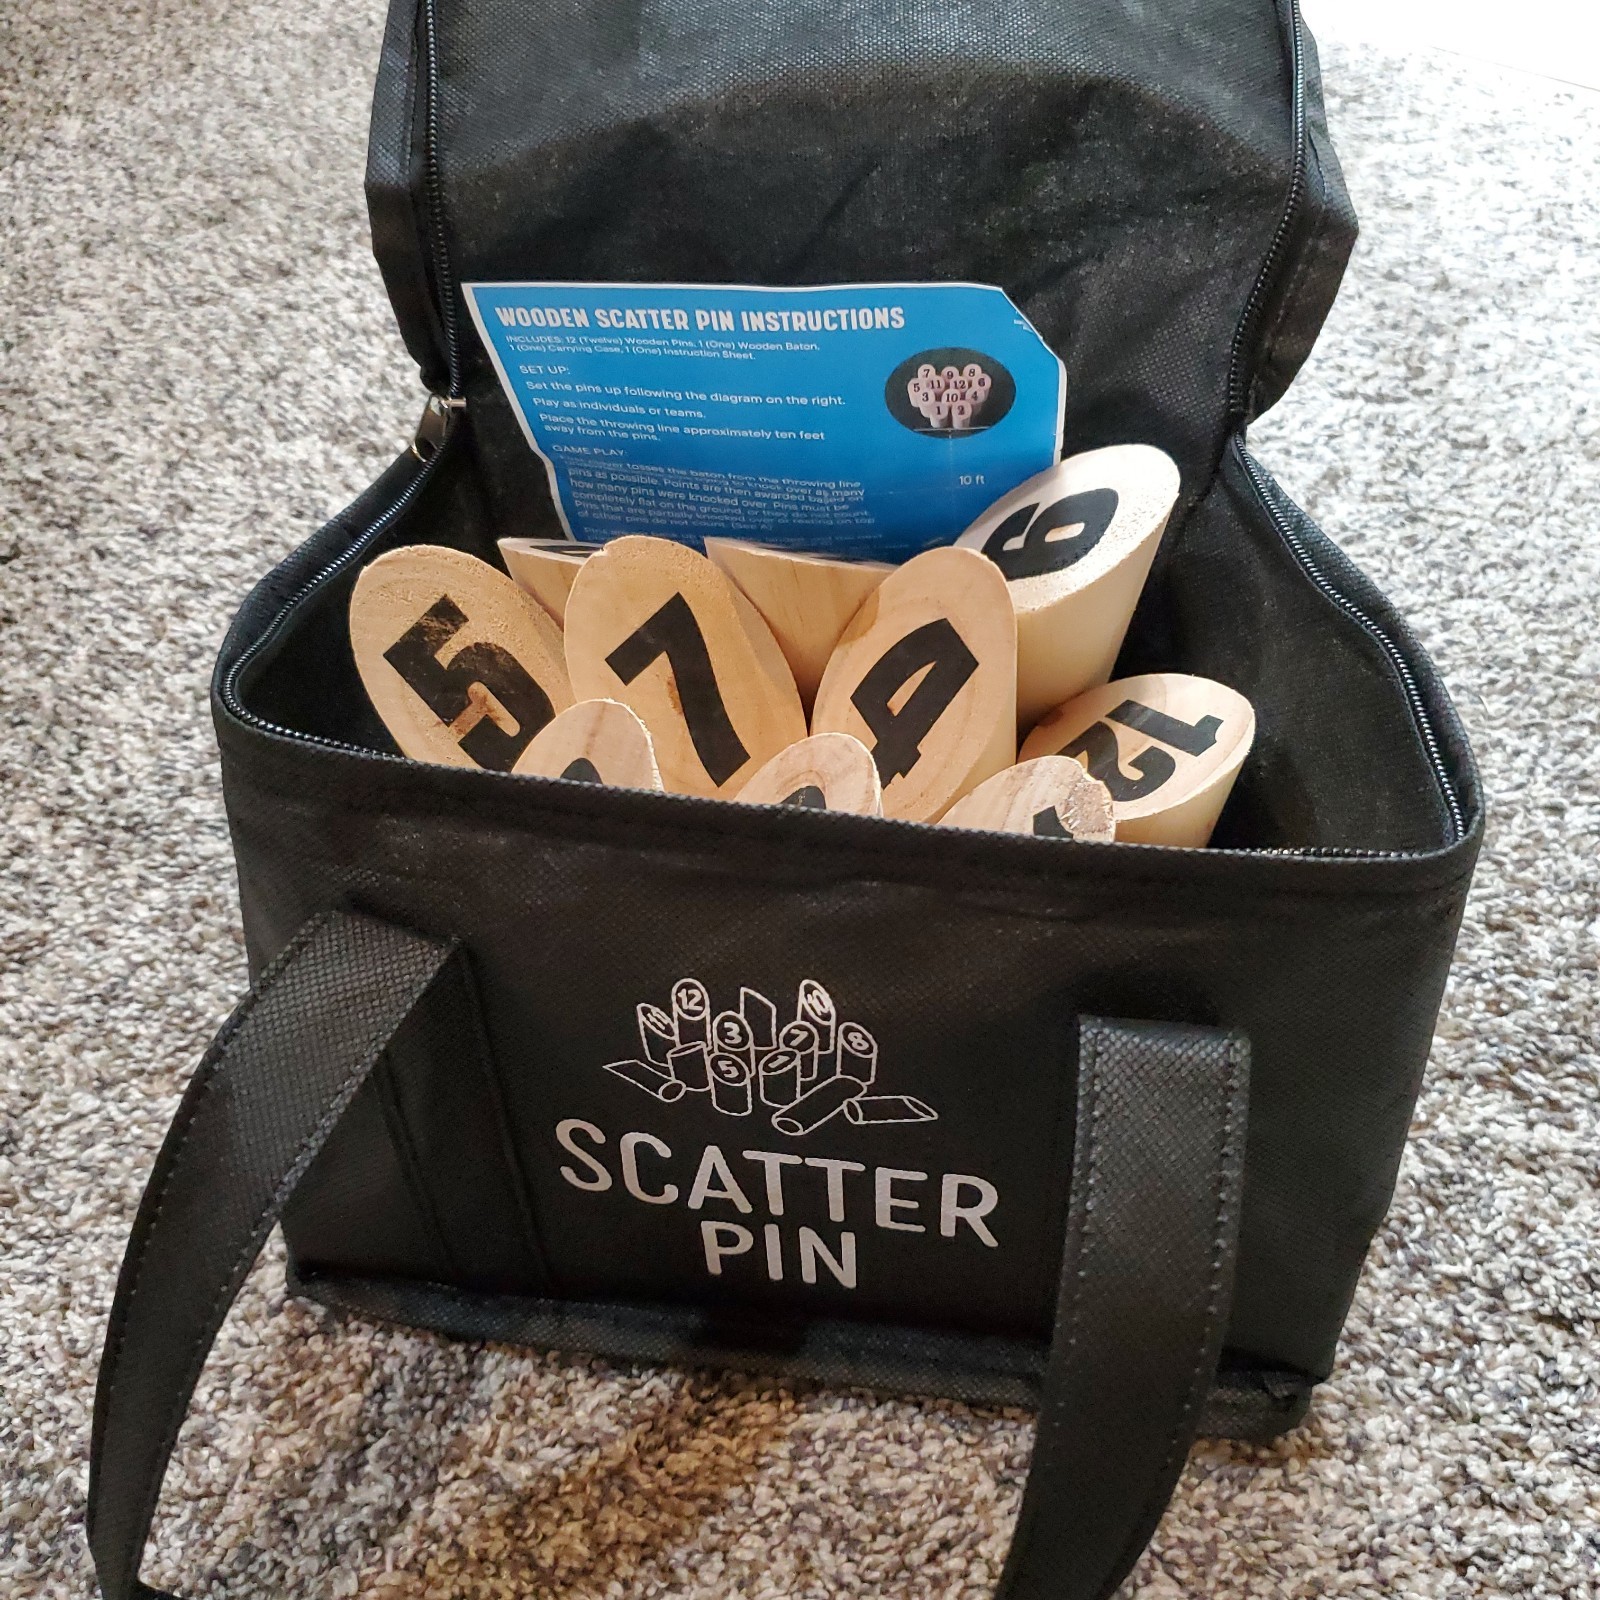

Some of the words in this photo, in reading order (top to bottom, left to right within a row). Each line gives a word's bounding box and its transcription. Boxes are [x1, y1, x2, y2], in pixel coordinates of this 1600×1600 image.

[495, 307, 590, 328] WOODEN
[594, 308, 690, 330] SCATTER
[695, 309, 735, 331] PIN
[741, 306, 905, 332] INSTRUCTIONS
[517, 344, 546, 353] (One)
[548, 345, 593, 354] Carrying
[632, 347, 662, 356] (One)
[664, 347, 720, 358] Instruction
[722, 350, 756, 360] Sheet.
[565, 336, 576, 344] 12
[579, 336, 623, 346] (Twelve)
[624, 337, 670, 347] Wooden
[705, 340, 735, 350] (One)
[738, 341, 783, 351] Wooden
[519, 365, 544, 375] SET
[548, 366, 570, 375] UP:
[923, 369, 930, 378] 7
[946, 371, 953, 379] 9
[968, 369, 975, 377] 8
[913, 383, 920, 392] 5
[931, 380, 940, 389] 11
[954, 380, 966, 389] 12
[978, 378, 985, 387] 6
[526, 381, 548, 390] Set
[550, 382, 572, 391] the
[576, 384, 601, 393] pins
[605, 387, 622, 395] up
[624, 386, 682, 400] following
[685, 391, 707, 401] the
[710, 392, 763, 404] diagram
[766, 396, 783, 404] on
[785, 396, 808, 405] the
[811, 396, 846, 407] right.
[922, 392, 929, 401] 3
[946, 393, 958, 402] 10
[971, 391, 978, 400] 4
[532, 397, 560, 408] Play
[562, 400, 577, 408] as
[579, 402, 646, 415] individuals
[648, 407, 662, 415] or
[664, 408, 706, 419] teams.
[958, 405, 965, 415] 2
[539, 413, 574, 424] Place
[576, 416, 598, 427] the
[600, 419, 655, 433] throwing
[657, 424, 680, 434] line
[683, 427, 772, 440] approximately
[775, 430, 796, 439] ten
[799, 430, 825, 440] feet
[544, 424, 574, 435] away
[577, 426, 605, 436] from
[608, 429, 629, 439] the
[632, 430, 661, 441] pins.
[552, 444, 592, 455] GAME
[568, 468, 592, 478] pins
[594, 471, 607, 479] as
[663, 479, 700, 490] Points
[702, 484, 721, 493] are
[724, 486, 751, 496] then
[754, 491, 805, 501] awarded
[627, 463, 665, 473] tosses
[667, 467, 687, 475] the
[689, 469, 725, 479] baton
[728, 473, 755, 481] from
[782, 478, 835, 489] throwing
[839, 480, 861, 488] line
[959, 475, 971, 485] 10
[975, 474, 985, 485] ft
[570, 478, 593, 489] how
[597, 482, 628, 494] many
[631, 487, 655, 497] pins
[657, 489, 686, 500] were
[689, 492, 739, 506] knocked
[773, 502, 798, 510] Pins
[573, 491, 635, 505] completely
[638, 497, 656, 507] flat
[677, 503, 696, 511] the
[575, 500, 599, 510] Pins
[601, 504, 624, 512] that
[383, 594, 556, 772] 5
[605, 591, 751, 788] 7
[850, 618, 979, 790] 4
[1055, 700, 1224, 802] 12
[677, 988, 704, 1011] 12
[807, 989, 832, 1016] 10
[646, 1008, 666, 1030] 11
[724, 1022, 743, 1044] 3
[790, 1028, 808, 1046] 7
[847, 1032, 870, 1051] 8
[717, 1060, 740, 1078] 5
[768, 1055, 790, 1069] 1
[555, 1118, 999, 1248] SCATTER
[700, 1220, 857, 1290] PIN
